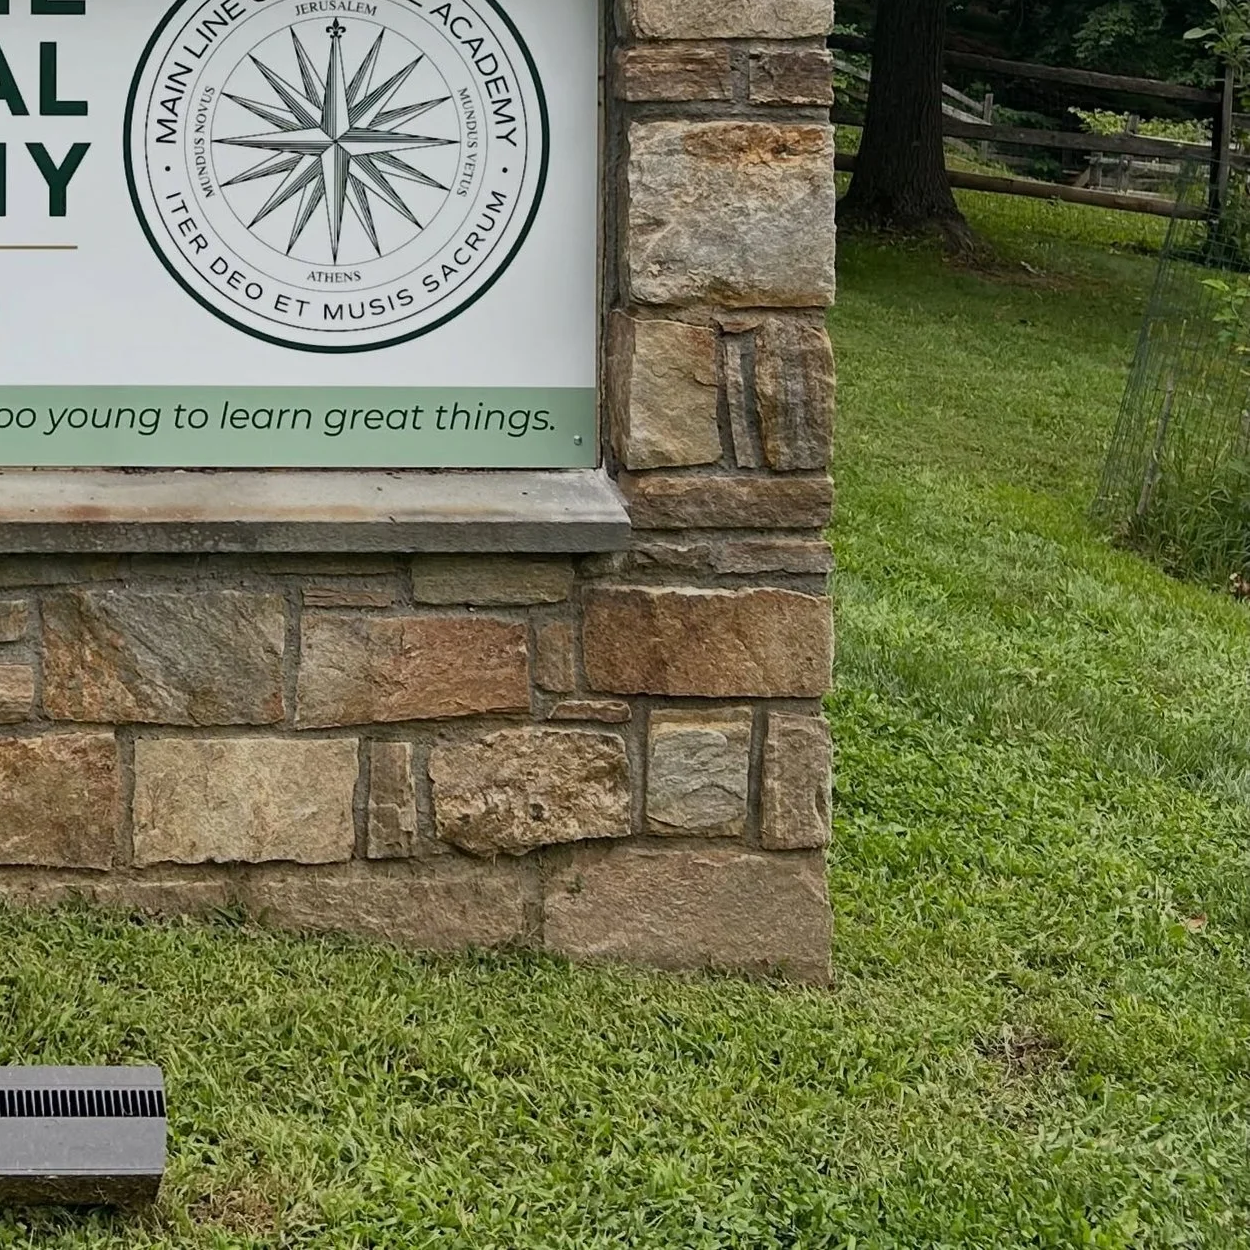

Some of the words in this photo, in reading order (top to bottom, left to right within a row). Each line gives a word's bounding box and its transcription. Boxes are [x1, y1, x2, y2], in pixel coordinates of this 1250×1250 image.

[294, 0, 378, 16] JERUSALEM
[156, 62, 193, 144] MAIN
[430, 3, 518, 148] ACADEMY
[194, 86, 215, 134] NOVUS
[457, 87, 478, 148] MUNDUS
[194, 137, 216, 199] MUNDUS
[456, 153, 478, 197] VETUS
[165, 191, 209, 255] ITER
[210, 256, 263, 300] DEO
[273, 294, 310, 317] ET
[323, 289, 414, 320] MUSIS
[422, 190, 507, 294] SACRUM
[306, 270, 362, 283] ATHENS
[43, 405, 161, 436] young
[173, 402, 209, 430] to
[220, 401, 312, 430] learn
[323, 403, 424, 437] great
[434, 402, 557, 437] things.
